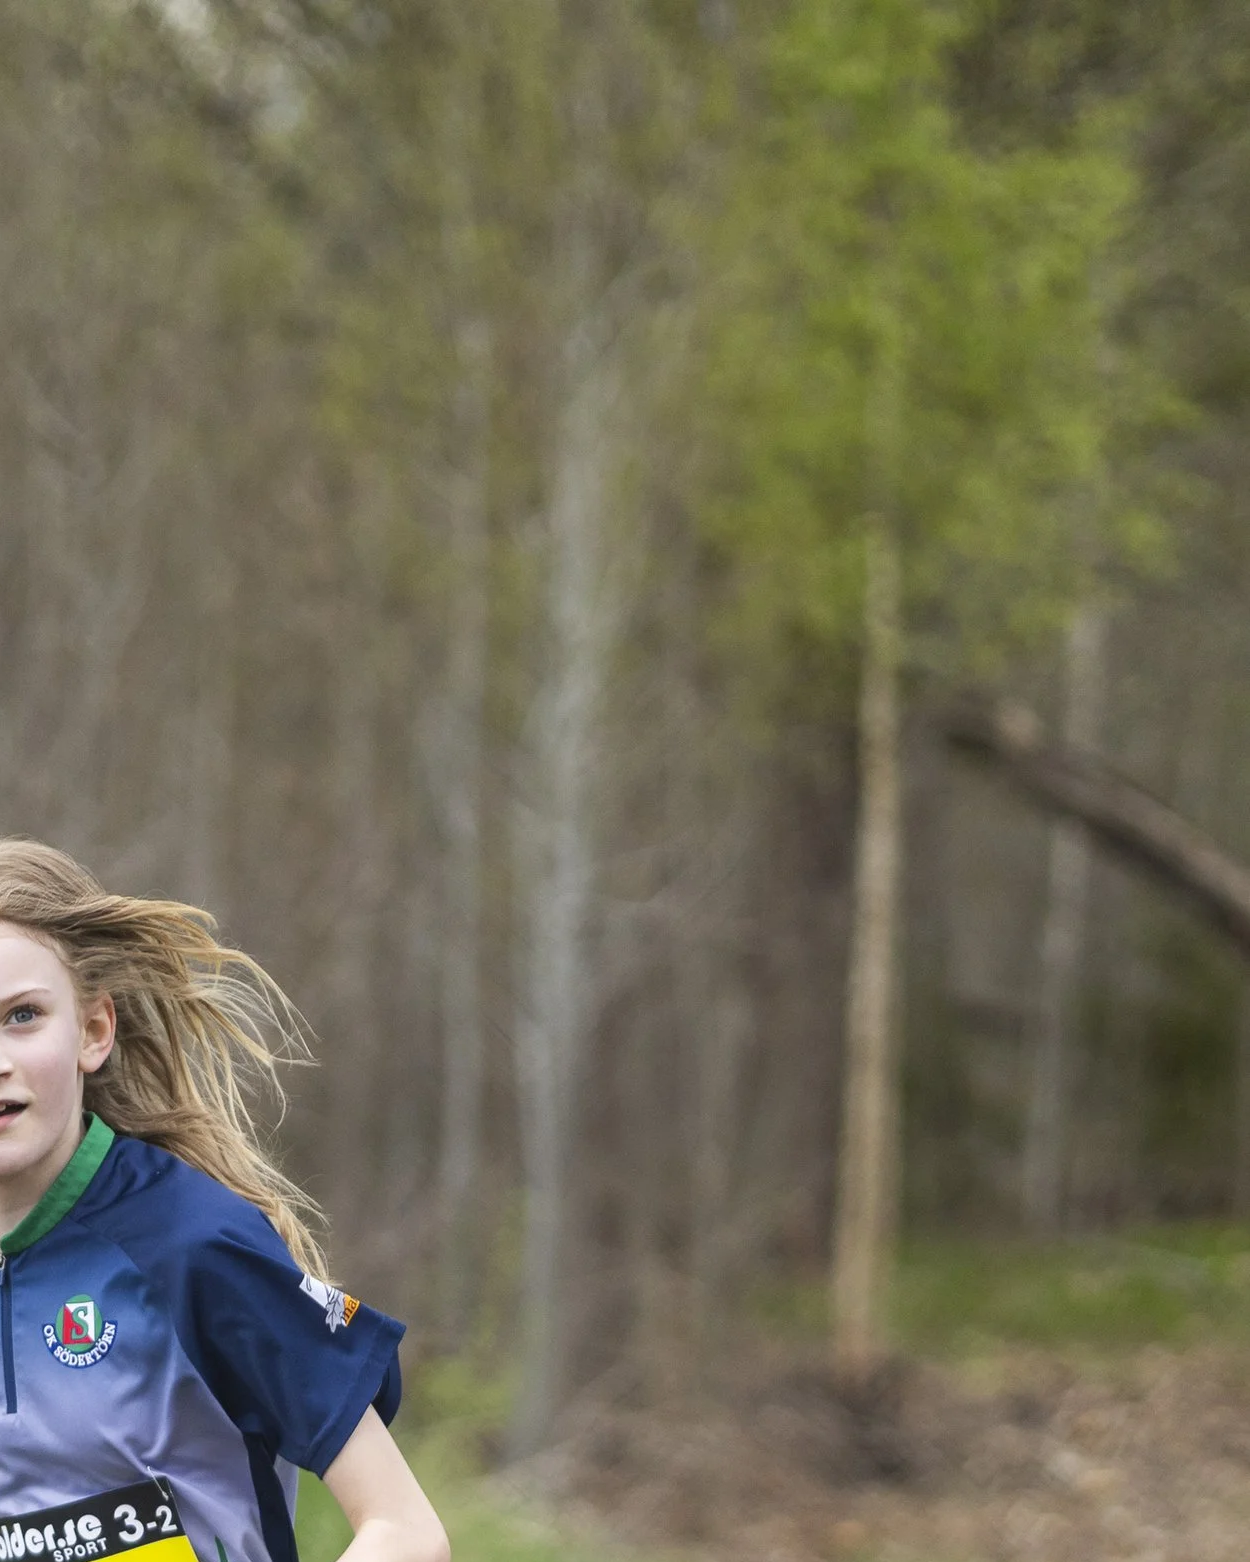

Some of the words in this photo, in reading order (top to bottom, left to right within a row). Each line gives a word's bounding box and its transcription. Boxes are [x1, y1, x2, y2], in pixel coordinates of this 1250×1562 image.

[43, 1324, 58, 1349] OK
[53, 1321, 117, 1367] SÖDERTÖRN
[113, 1503, 178, 1543] 3-2
